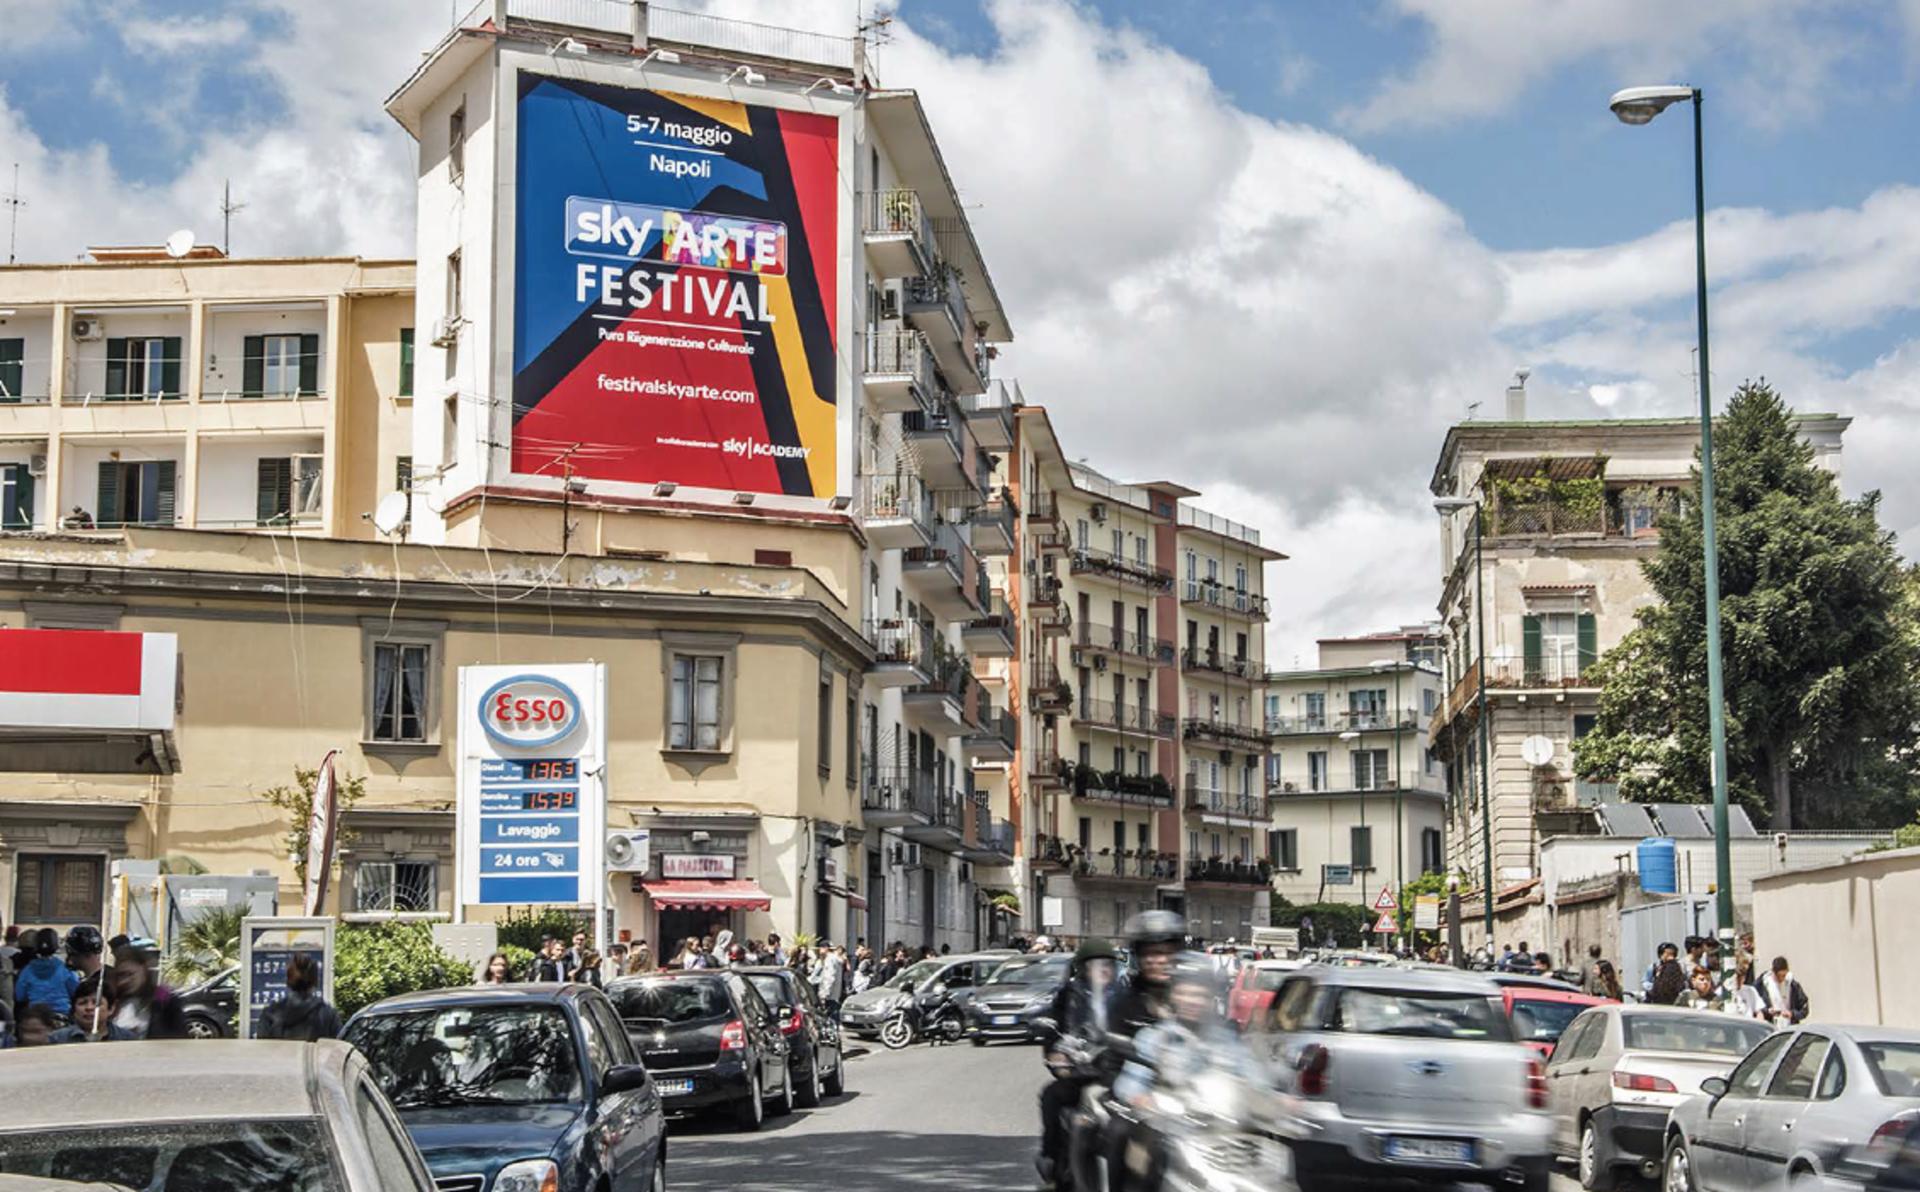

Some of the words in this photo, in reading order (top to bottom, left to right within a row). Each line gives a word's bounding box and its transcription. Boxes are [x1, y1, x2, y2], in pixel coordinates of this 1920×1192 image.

[627, 115, 659, 134] 5-7
[664, 121, 732, 146] maggio
[650, 154, 711, 178] Napoli
[577, 205, 652, 256] sky
[670, 221, 777, 266] ARTE
[577, 263, 776, 322] FESTIVAL
[598, 328, 624, 342] Pura
[707, 338, 755, 354] Culturale
[597, 374, 755, 403] festivalskyarte.com
[722, 438, 747, 456] sky
[753, 443, 811, 458] ACADEMY
[498, 822, 561, 839] Lavaggio
[494, 854, 513, 867] 24
[515, 855, 540, 867] ore
